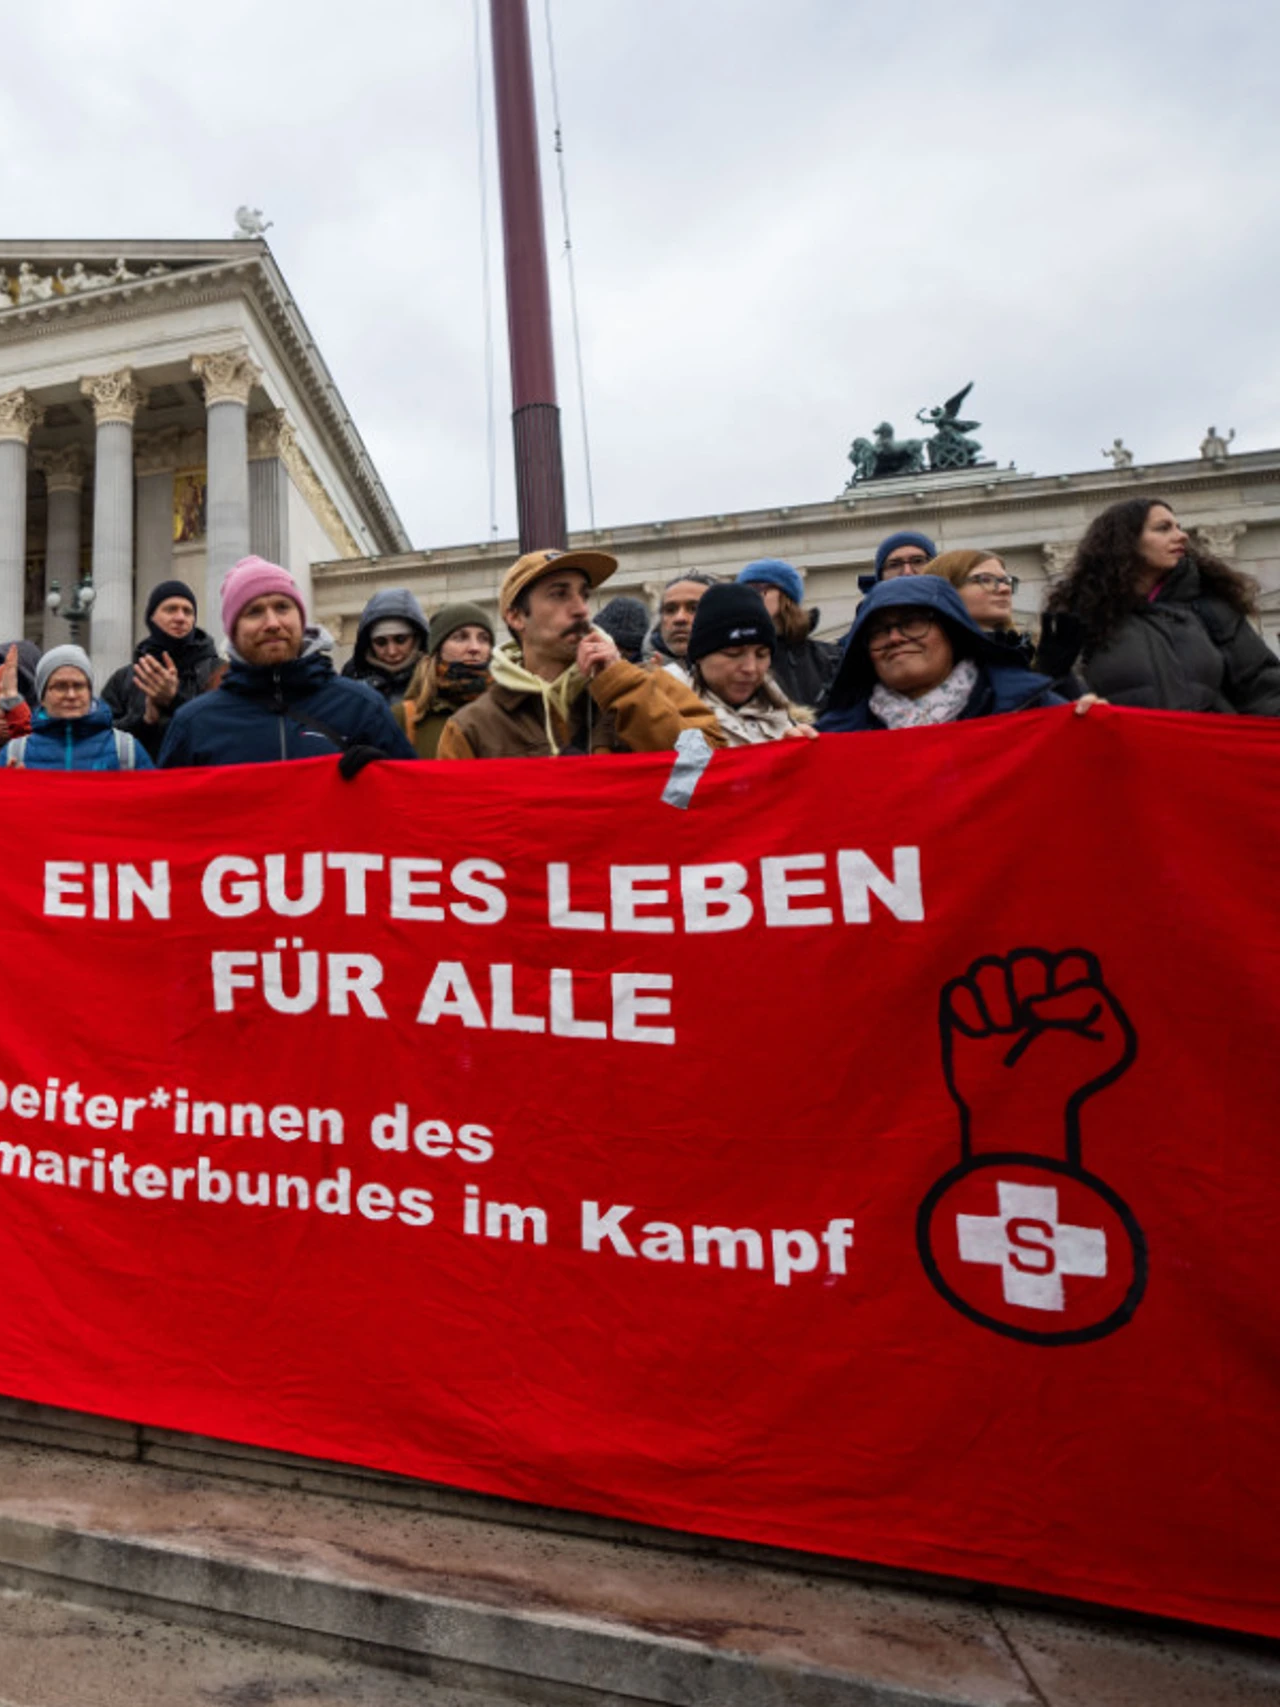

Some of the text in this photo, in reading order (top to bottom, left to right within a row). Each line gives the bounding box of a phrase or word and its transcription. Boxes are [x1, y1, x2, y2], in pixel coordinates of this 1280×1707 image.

[42, 846, 924, 934] EIN GUTES LEBEN
[211, 937, 676, 1045] FÜR ALLE
[370, 1103, 495, 1163] des
[463, 1185, 548, 1246] im
[581, 1200, 855, 1286] Kampf
[1006, 1218, 1055, 1277] S
